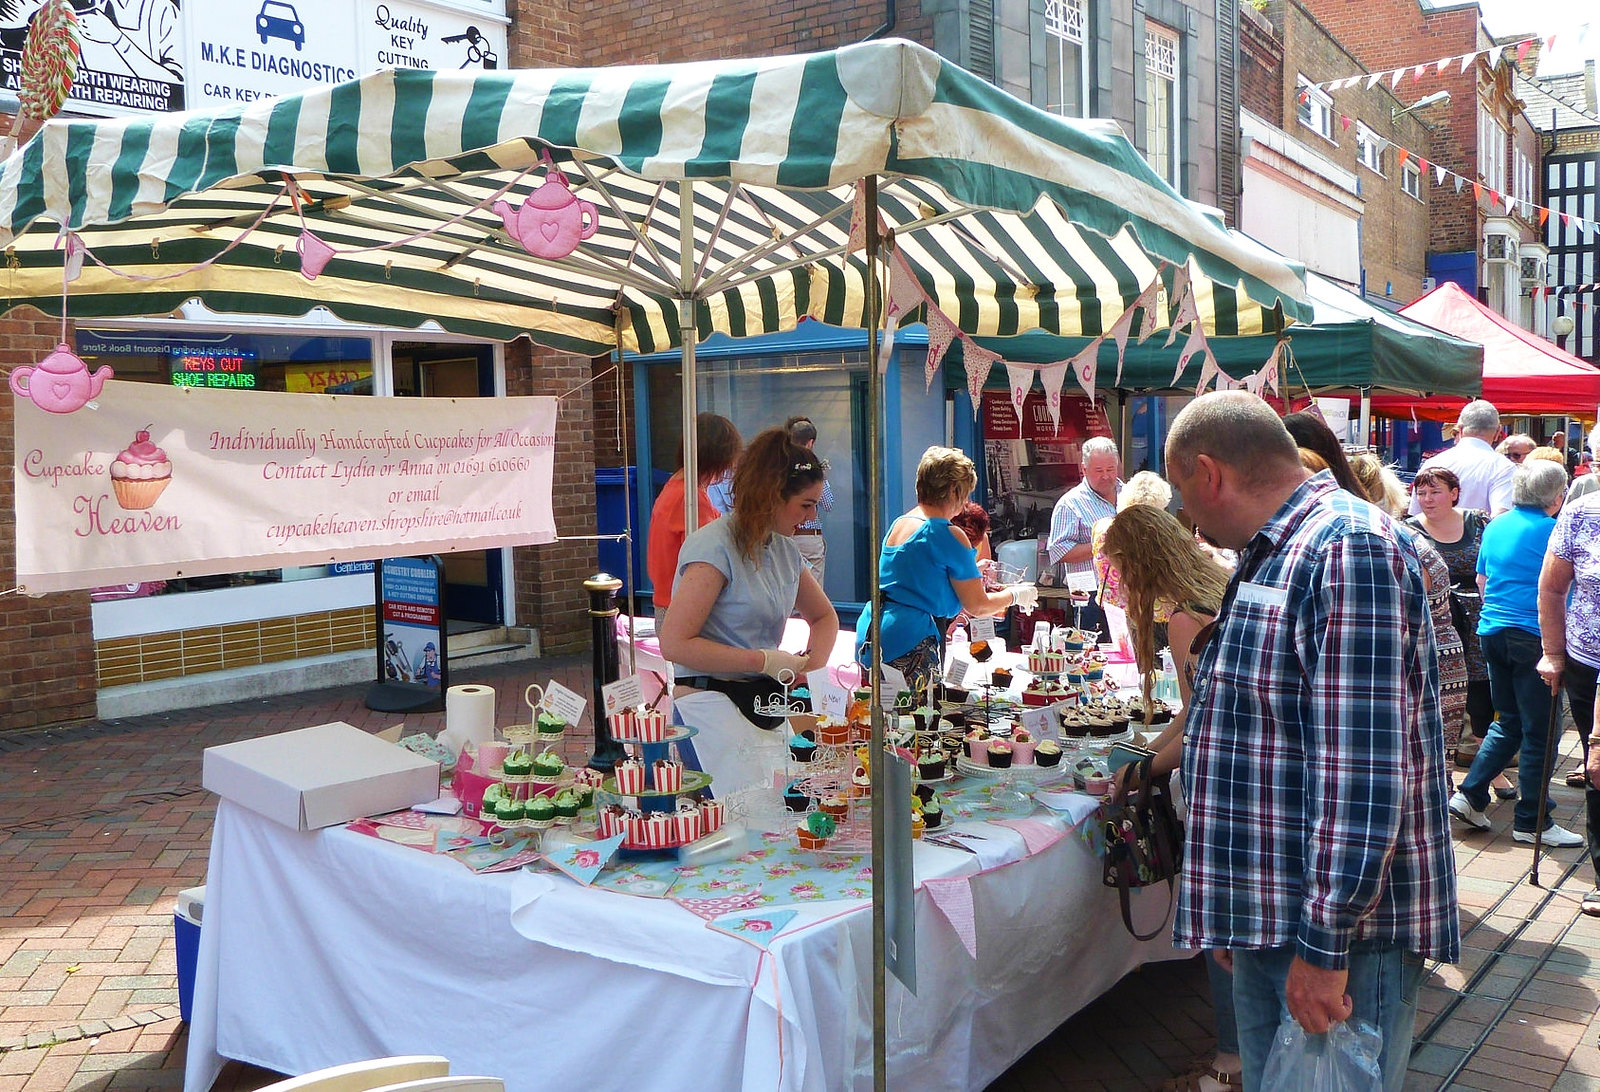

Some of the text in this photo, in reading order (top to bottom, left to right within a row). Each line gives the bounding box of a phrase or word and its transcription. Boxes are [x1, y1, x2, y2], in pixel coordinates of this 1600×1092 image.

[375, 4, 428, 40] Quality
[391, 34, 414, 50] KEY
[201, 41, 355, 84] M.K.E DIAGNOSTICS
[377, 50, 429, 69] CUTTING
[109, 74, 171, 97] WEARING
[203, 83, 261, 102] CAR KEY
[95, 88, 169, 111] REPAIRING!
[183, 357, 243, 371] KEYS CUT
[172, 372, 256, 387] SHOE REPAIRS
[209, 427, 316, 459] Individually
[320, 428, 411, 458] Handcrafted
[472, 428, 492, 456] for
[494, 427, 512, 448] All
[23, 449, 105, 489] Cupcake
[263, 456, 530, 488] Contact Lydia or Anna on 01691 610660
[388, 480, 443, 504] or email
[73, 494, 183, 538] Heaven
[266, 500, 523, 546] cupcakeheaven.shropshire@hotmail.co.uk
